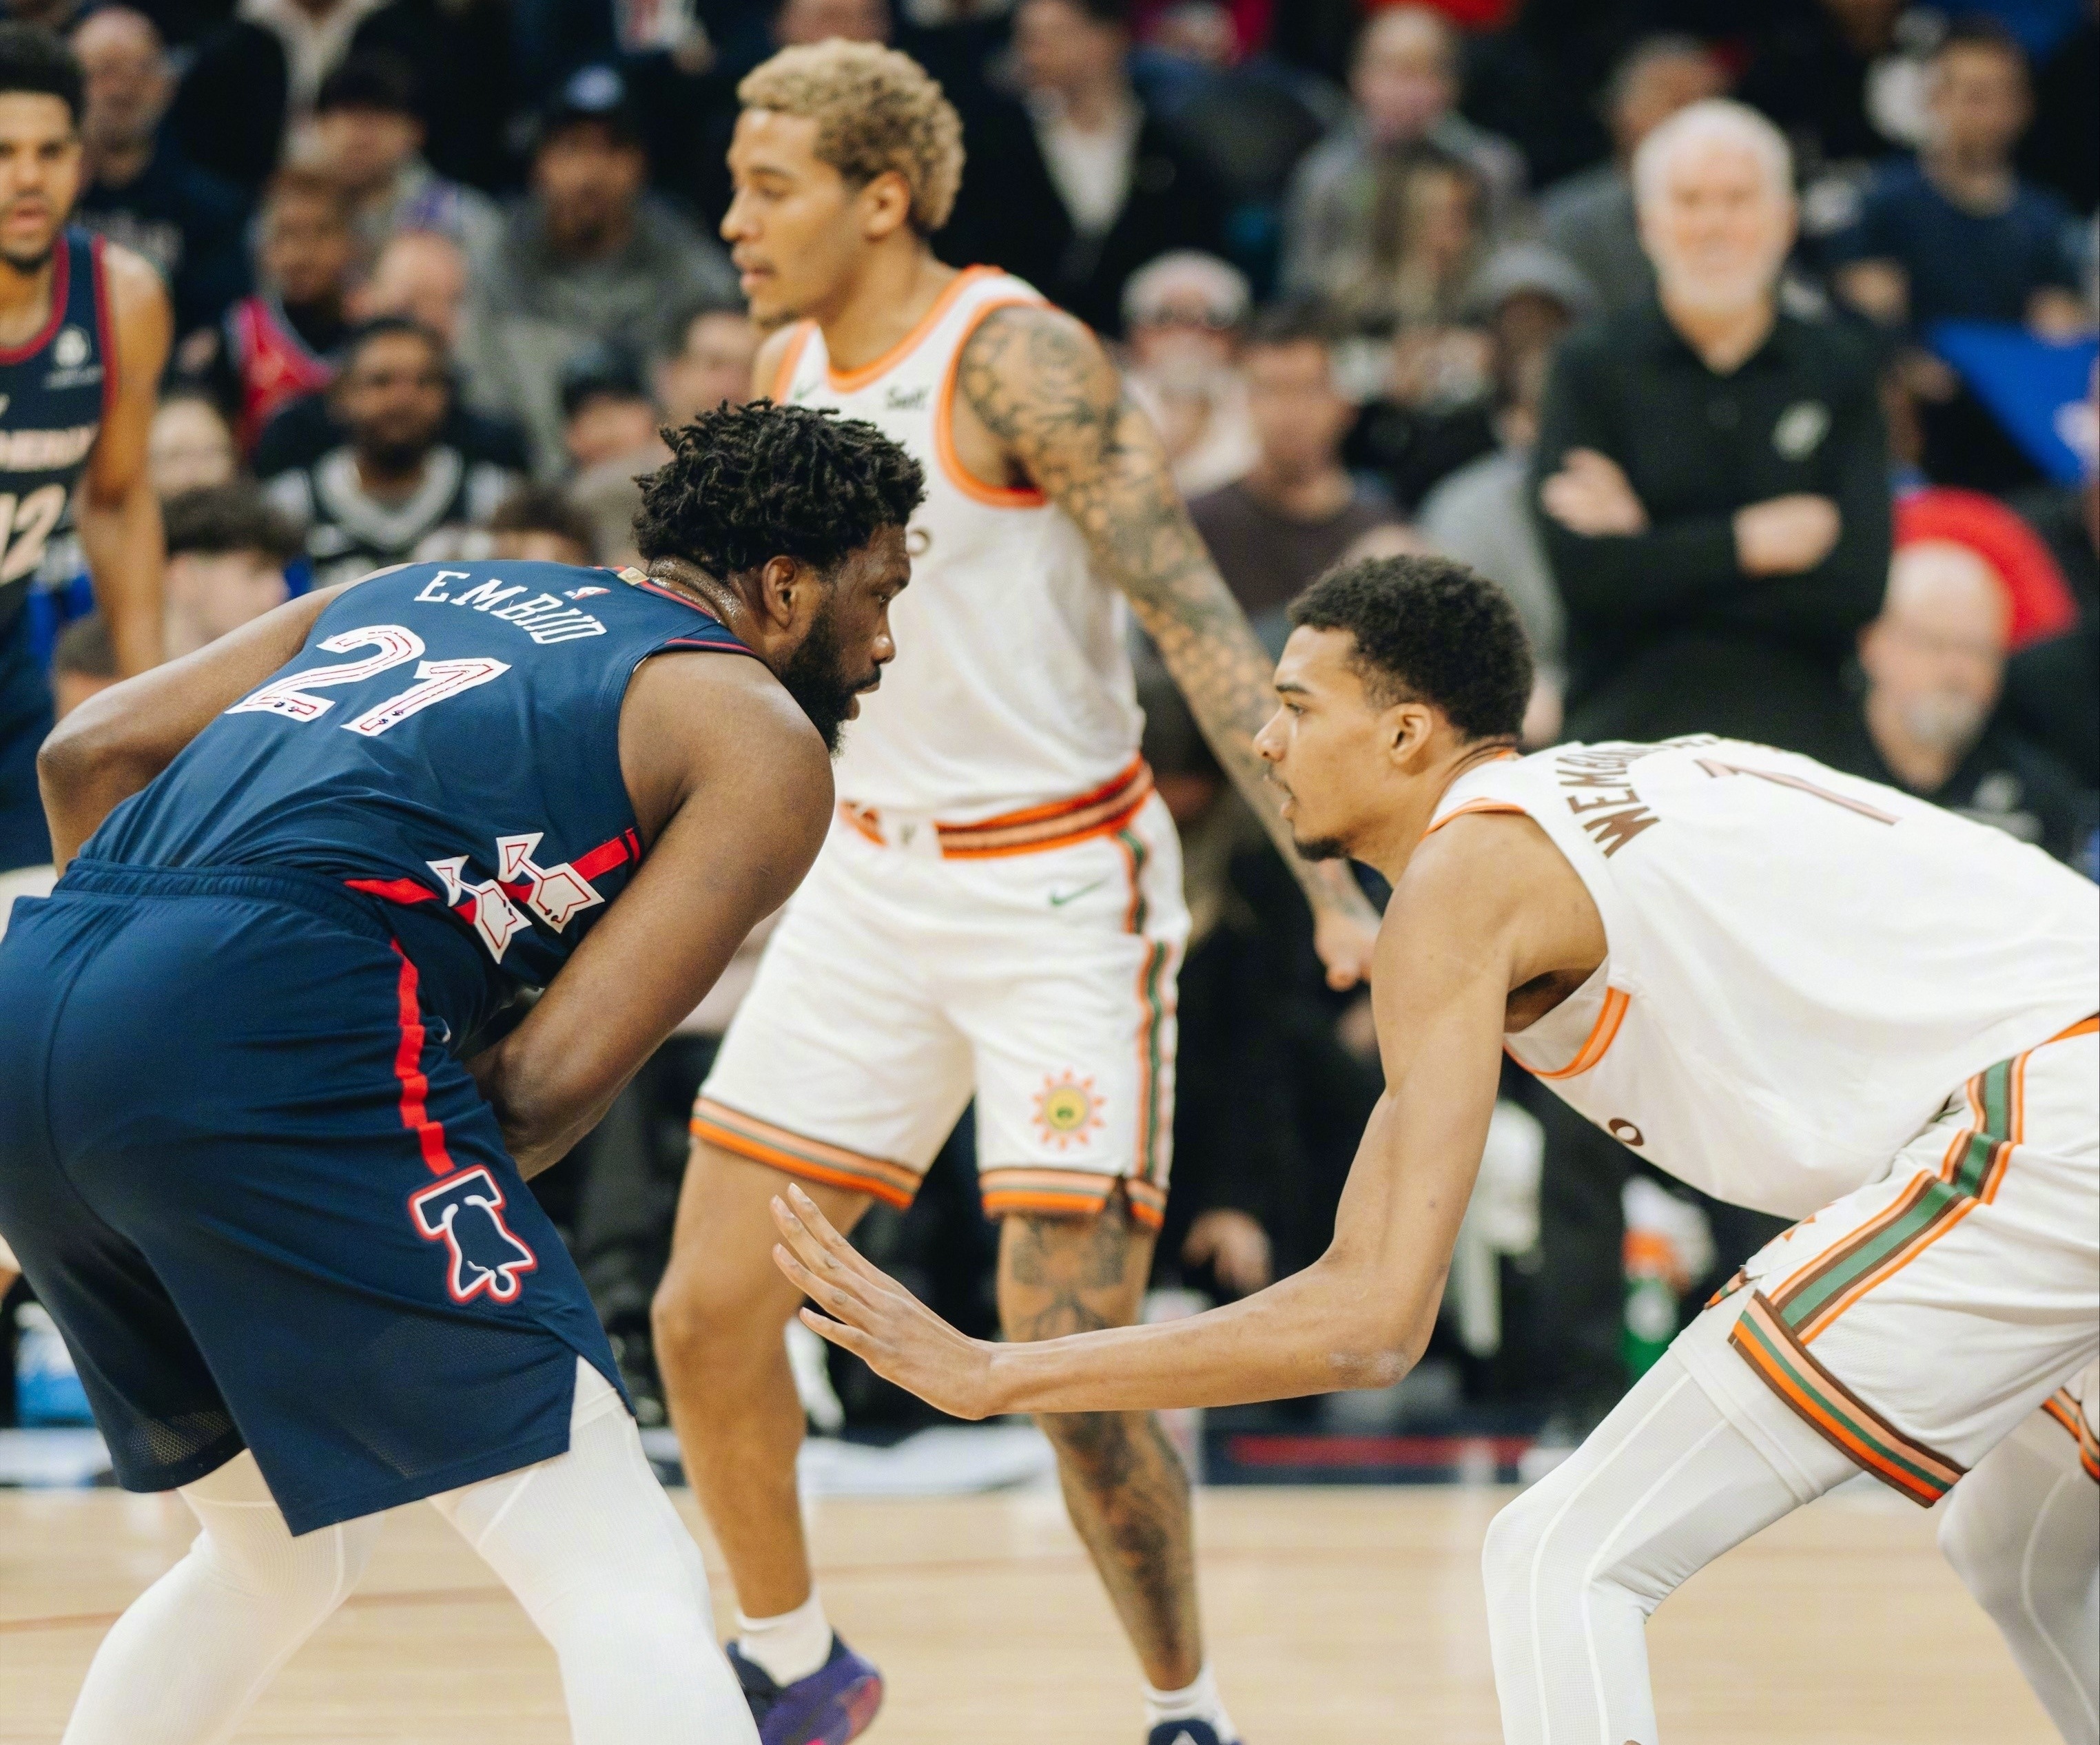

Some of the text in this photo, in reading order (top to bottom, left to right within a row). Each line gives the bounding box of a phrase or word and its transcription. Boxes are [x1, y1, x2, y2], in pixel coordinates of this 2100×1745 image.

[413, 570, 608, 644] EMBIID
[225, 625, 512, 737] 21
[1693, 758, 1904, 826] 1
